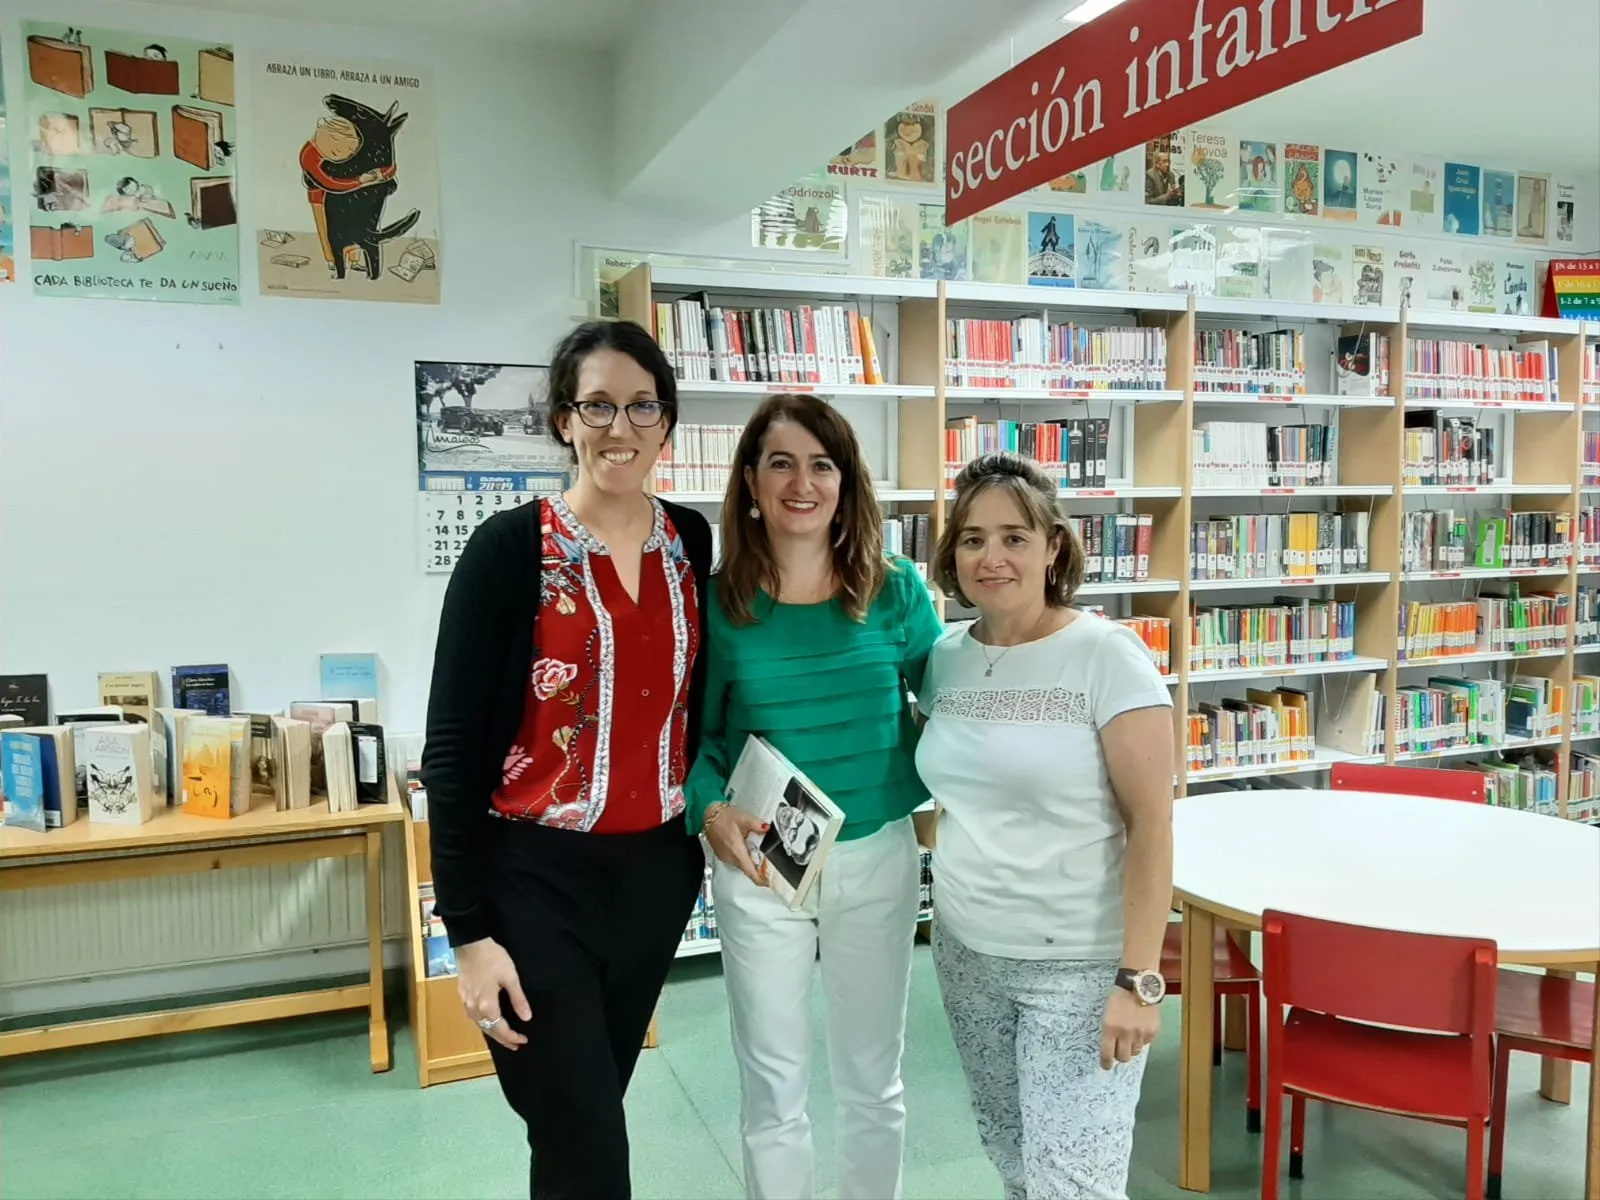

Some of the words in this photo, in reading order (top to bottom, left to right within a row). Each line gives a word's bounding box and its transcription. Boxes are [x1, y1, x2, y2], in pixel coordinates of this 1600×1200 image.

[266, 63, 297, 76] ABRAZA
[300, 66, 311, 77] UN
[313, 68, 338, 81] LIBRO,
[340, 70, 370, 83] ABRAZA
[372, 74, 377, 84] A
[380, 74, 391, 85] UN
[394, 76, 420, 88] AMIGO
[950, 67, 1104, 200] sección
[1191, 130, 1226, 145] Teresa
[1193, 143, 1228, 158] Novoa
[827, 165, 878, 178] KURTZ
[34, 273, 68, 287] CADA
[160, 277, 177, 289] DA
[457, 495, 463, 505] 1
[475, 495, 484, 505] 2
[495, 495, 503, 505] 3
[514, 495, 522, 505] 4
[437, 510, 445, 520] 7
[456, 510, 465, 520] 8
[475, 510, 484, 520] 9
[434, 525, 449, 535] 14
[455, 525, 469, 535] 15
[434, 540, 448, 550] 21
[434, 555, 451, 566] 28
